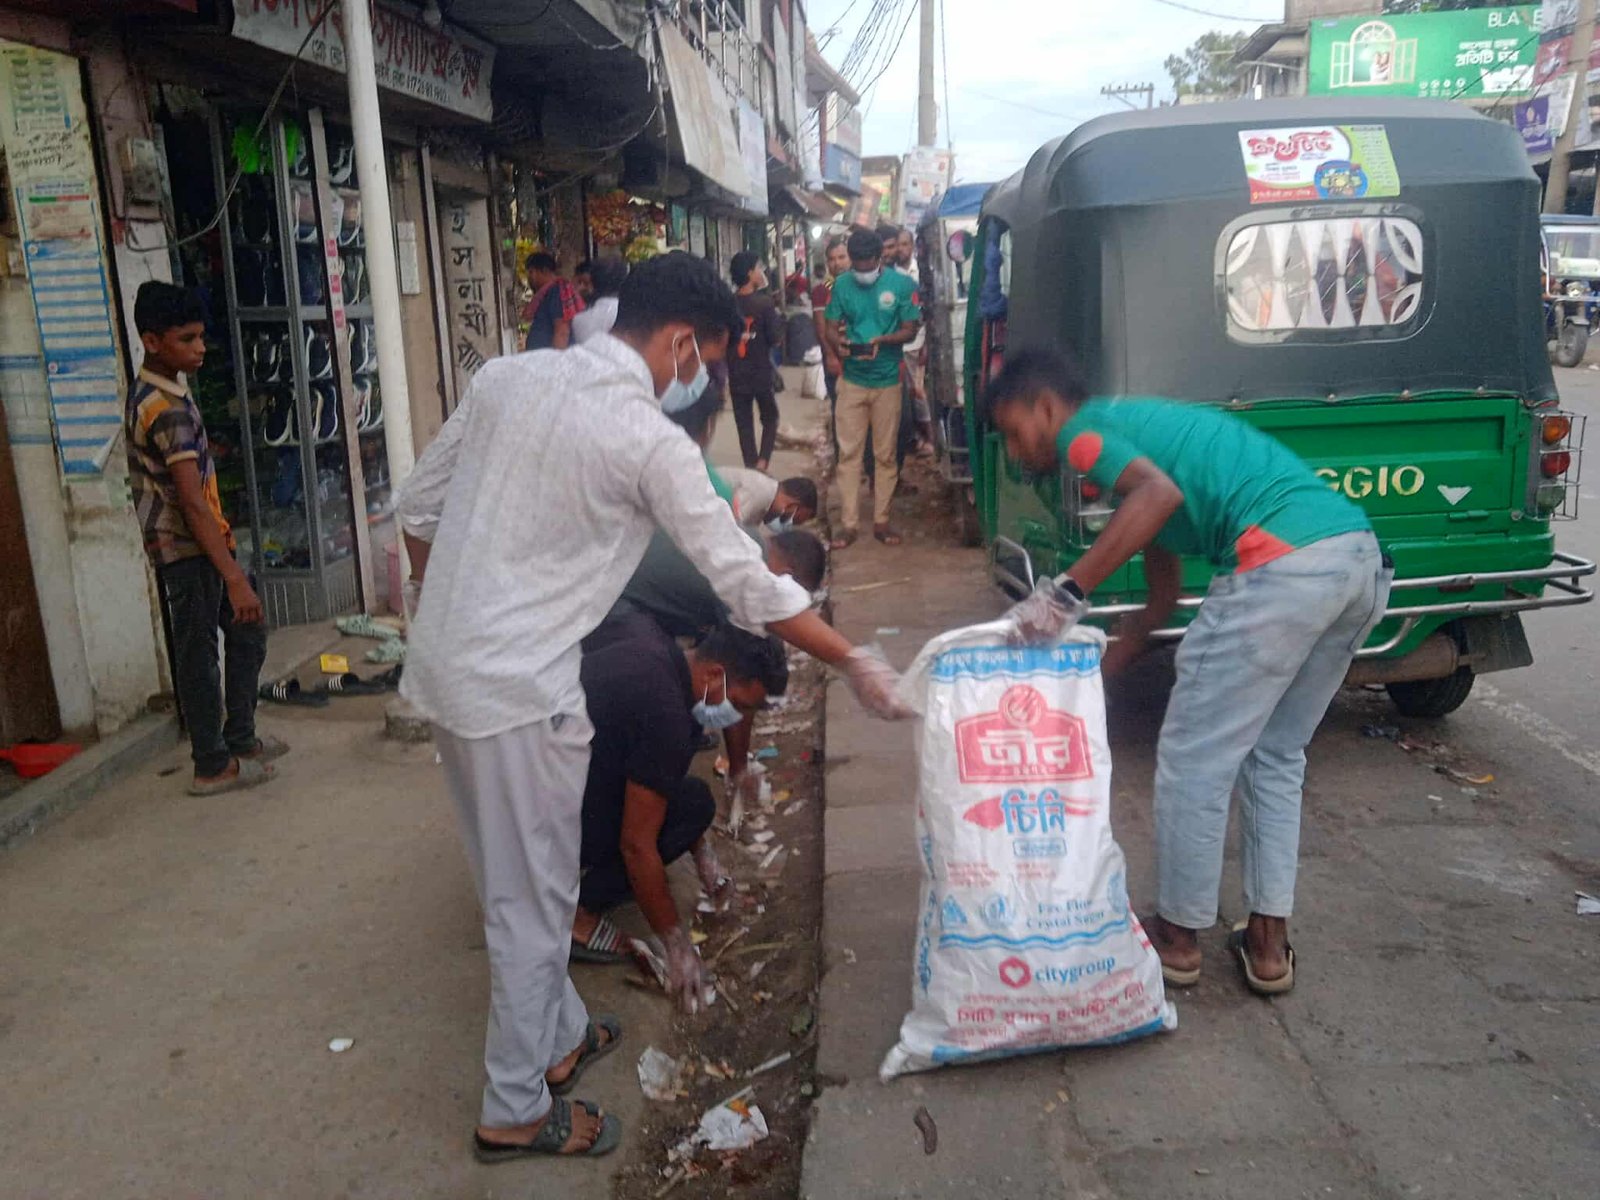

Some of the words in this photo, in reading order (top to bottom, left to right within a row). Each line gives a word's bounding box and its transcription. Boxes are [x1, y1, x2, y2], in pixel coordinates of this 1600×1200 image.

[1488, 11, 1542, 28] BLAE
[977, 729, 1072, 769] তীর
[1000, 788, 1067, 833] চিনি
[1035, 955, 1116, 983] citygroup
